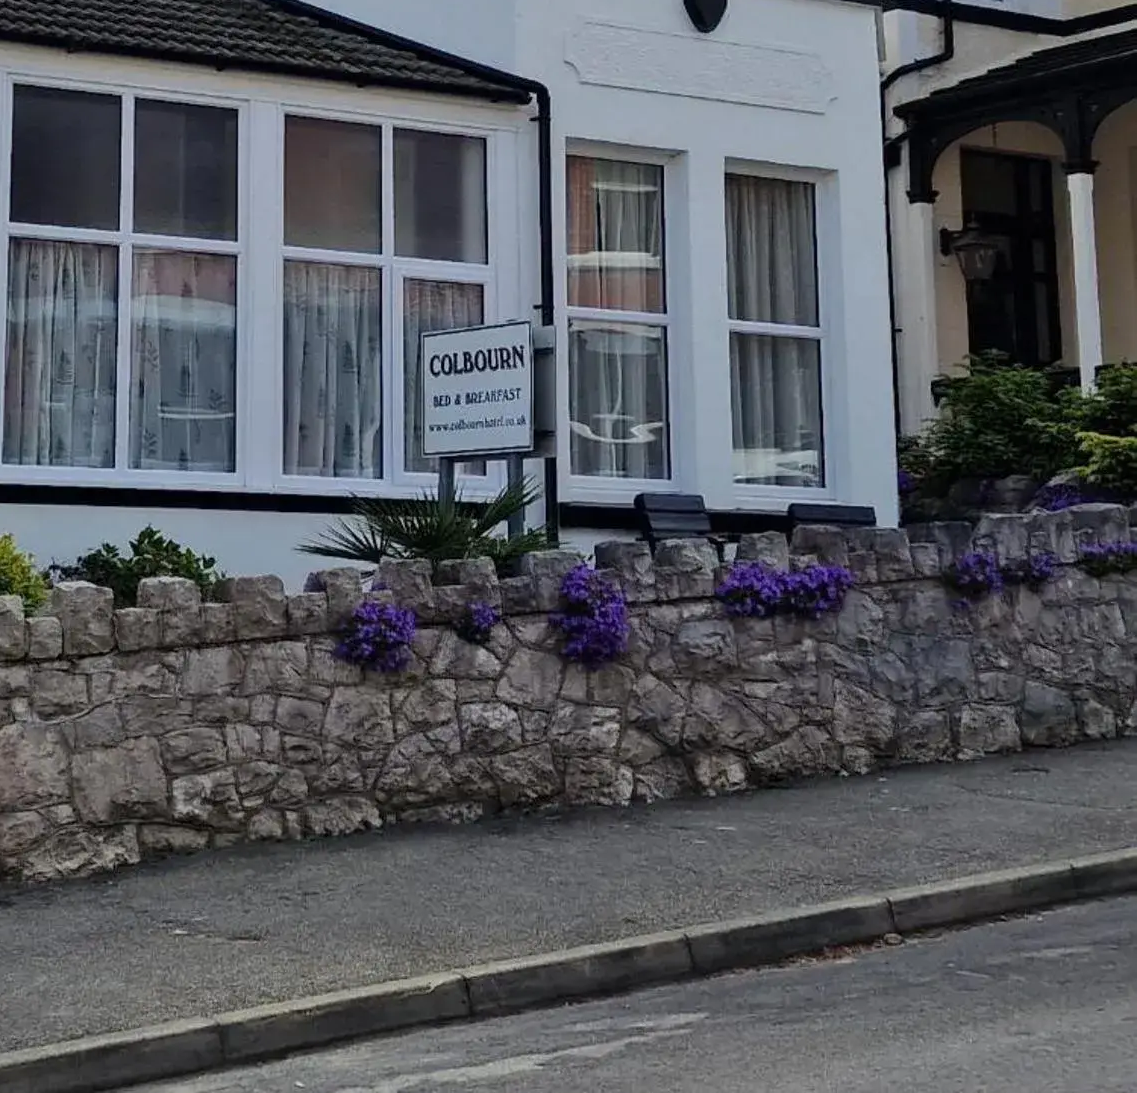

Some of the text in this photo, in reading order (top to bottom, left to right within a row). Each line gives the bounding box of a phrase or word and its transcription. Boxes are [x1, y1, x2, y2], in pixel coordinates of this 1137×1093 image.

[429, 345, 525, 377] COLBOURN
[433, 388, 522, 408] BED & BREAKFAST
